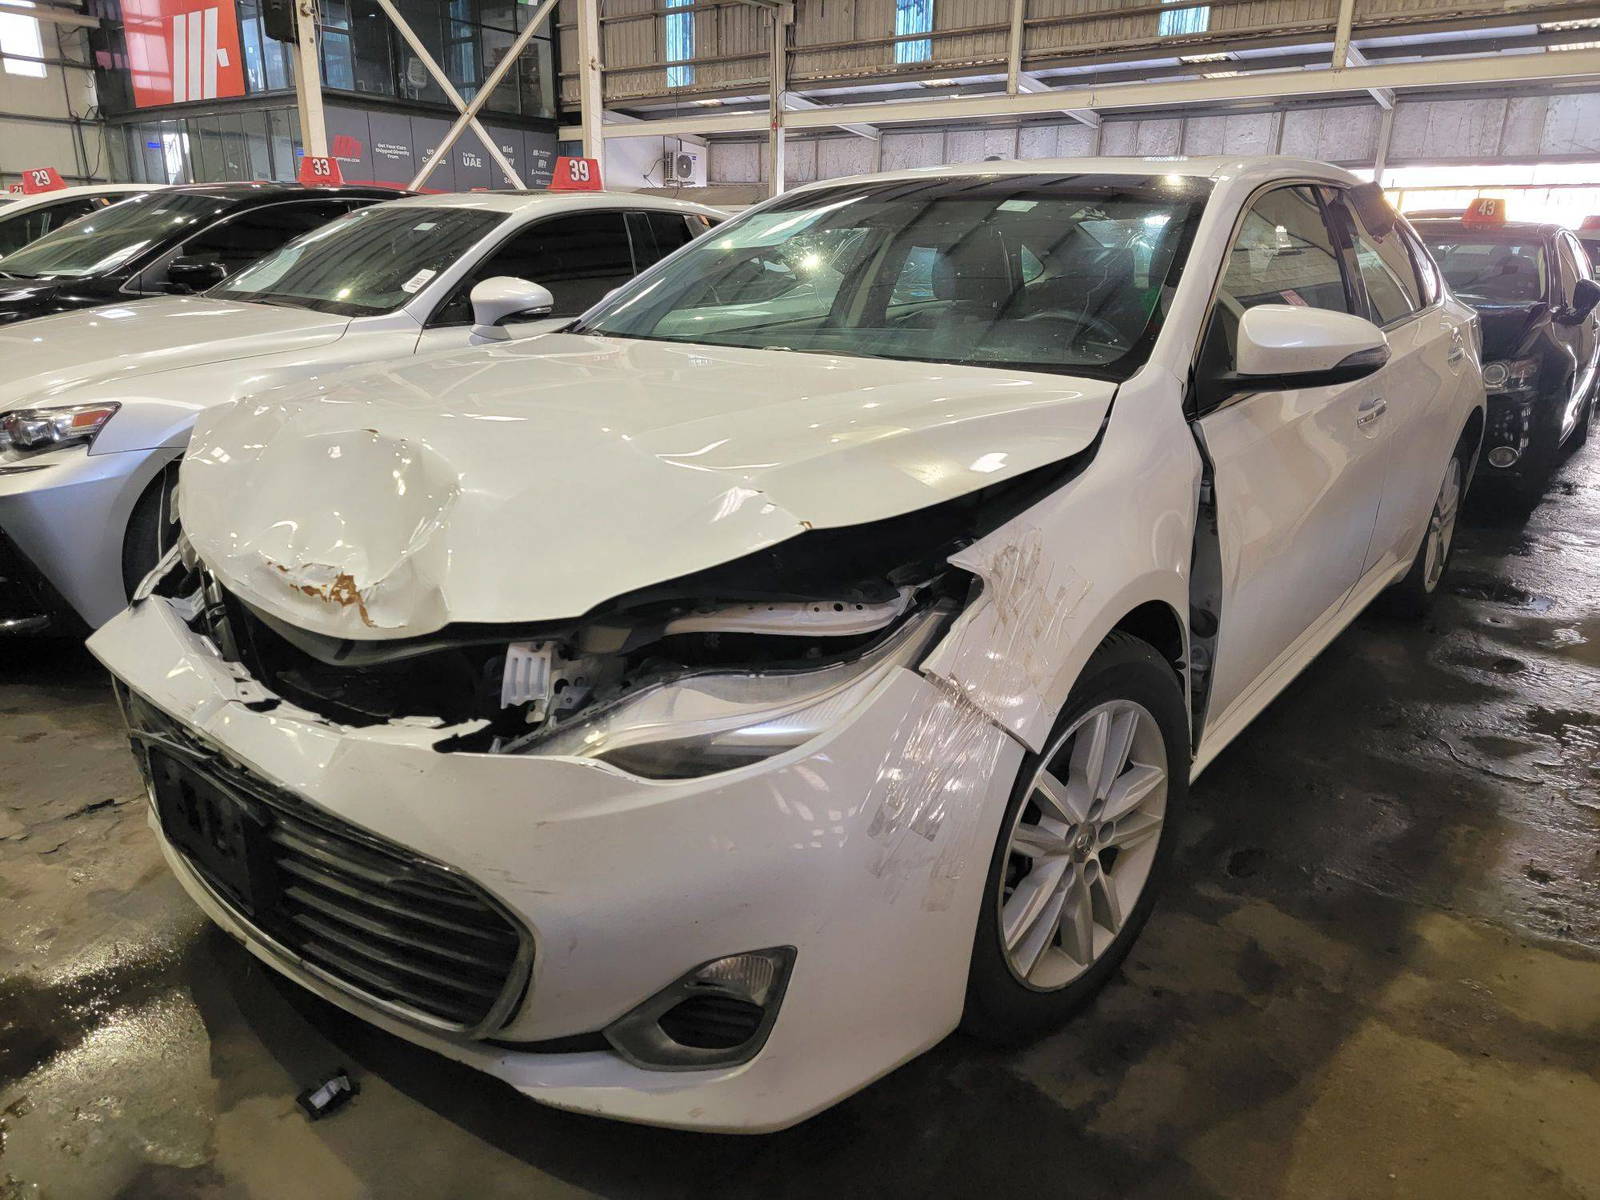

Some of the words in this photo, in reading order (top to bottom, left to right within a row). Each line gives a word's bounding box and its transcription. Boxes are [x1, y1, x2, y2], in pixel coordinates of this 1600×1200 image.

[502, 145, 513, 153] Bid
[312, 158, 331, 176] 33
[462, 157, 482, 168] UAE
[569, 159, 590, 182] 39
[32, 169, 51, 187] 29
[1478, 200, 1496, 216] 43
